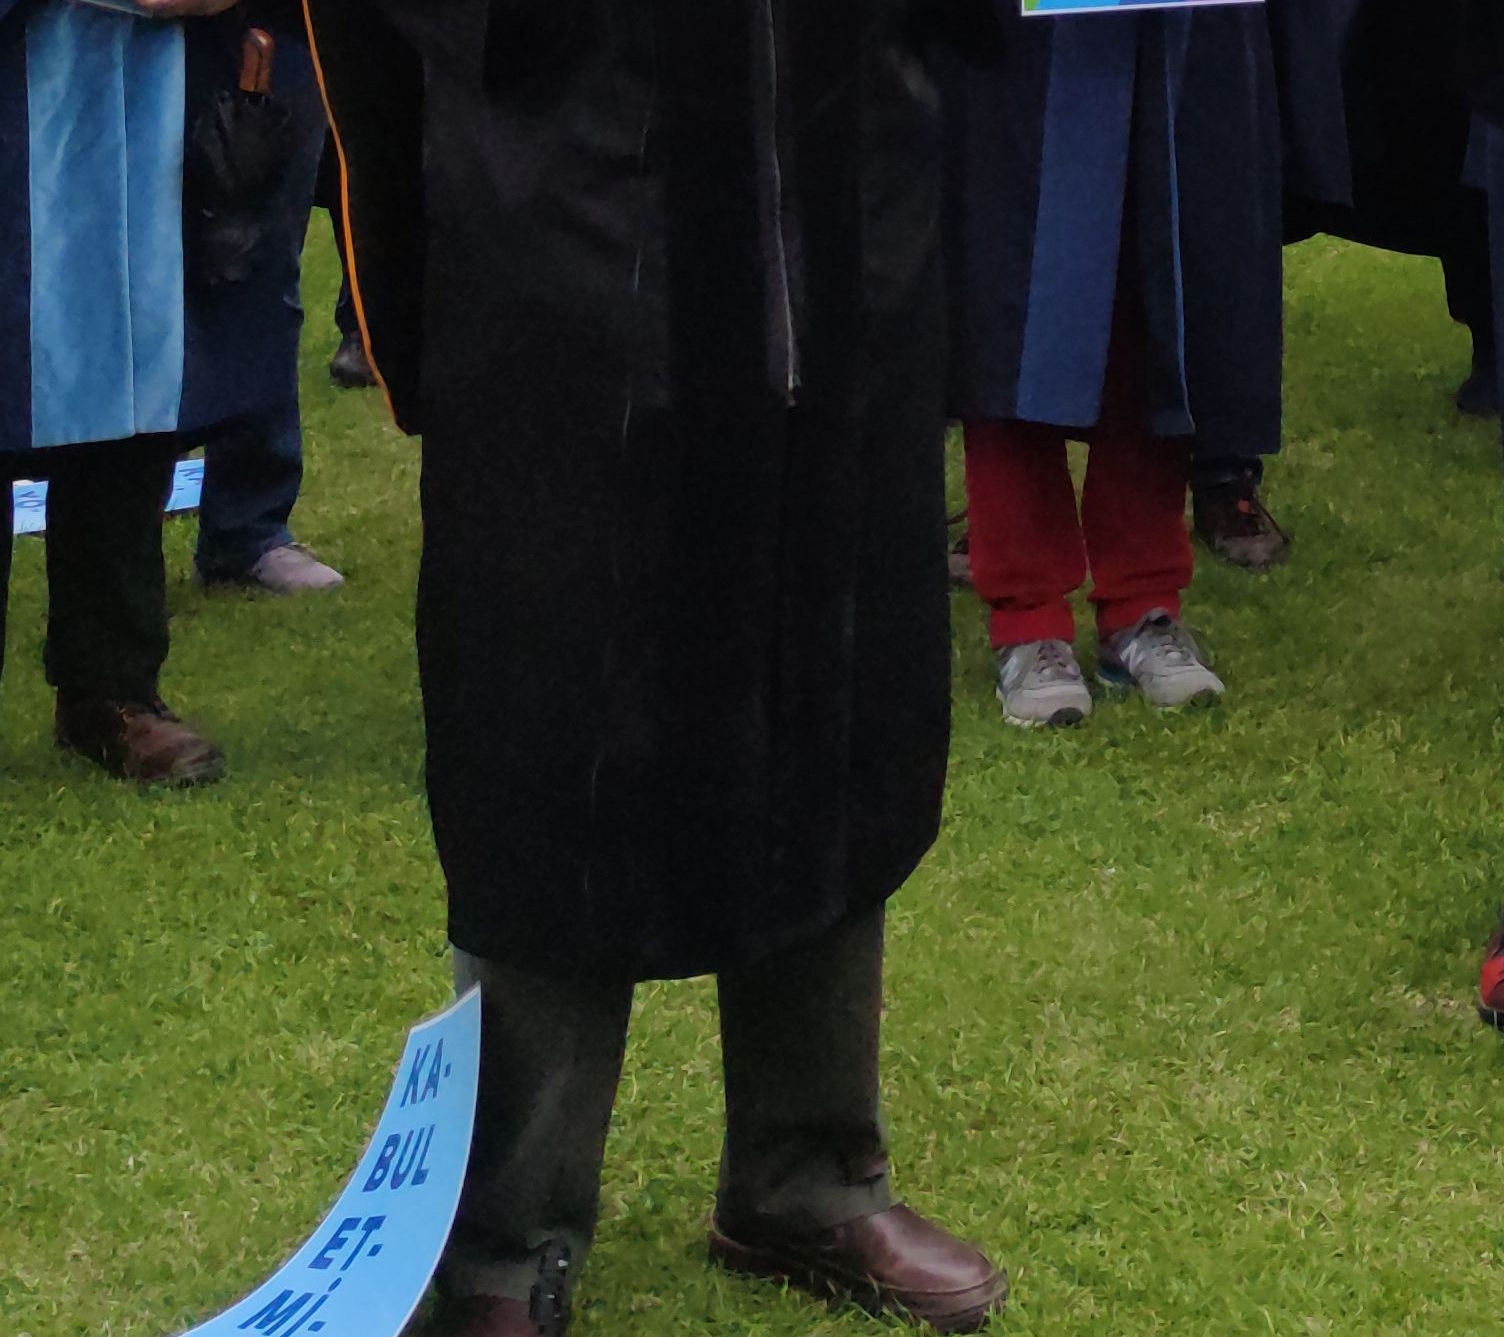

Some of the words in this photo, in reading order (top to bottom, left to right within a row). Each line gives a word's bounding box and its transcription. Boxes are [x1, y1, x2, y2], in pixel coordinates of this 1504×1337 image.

[399, 1036, 452, 1110] KA-
[361, 1123, 437, 1194] BUL
[306, 1214, 387, 1272] ET-
